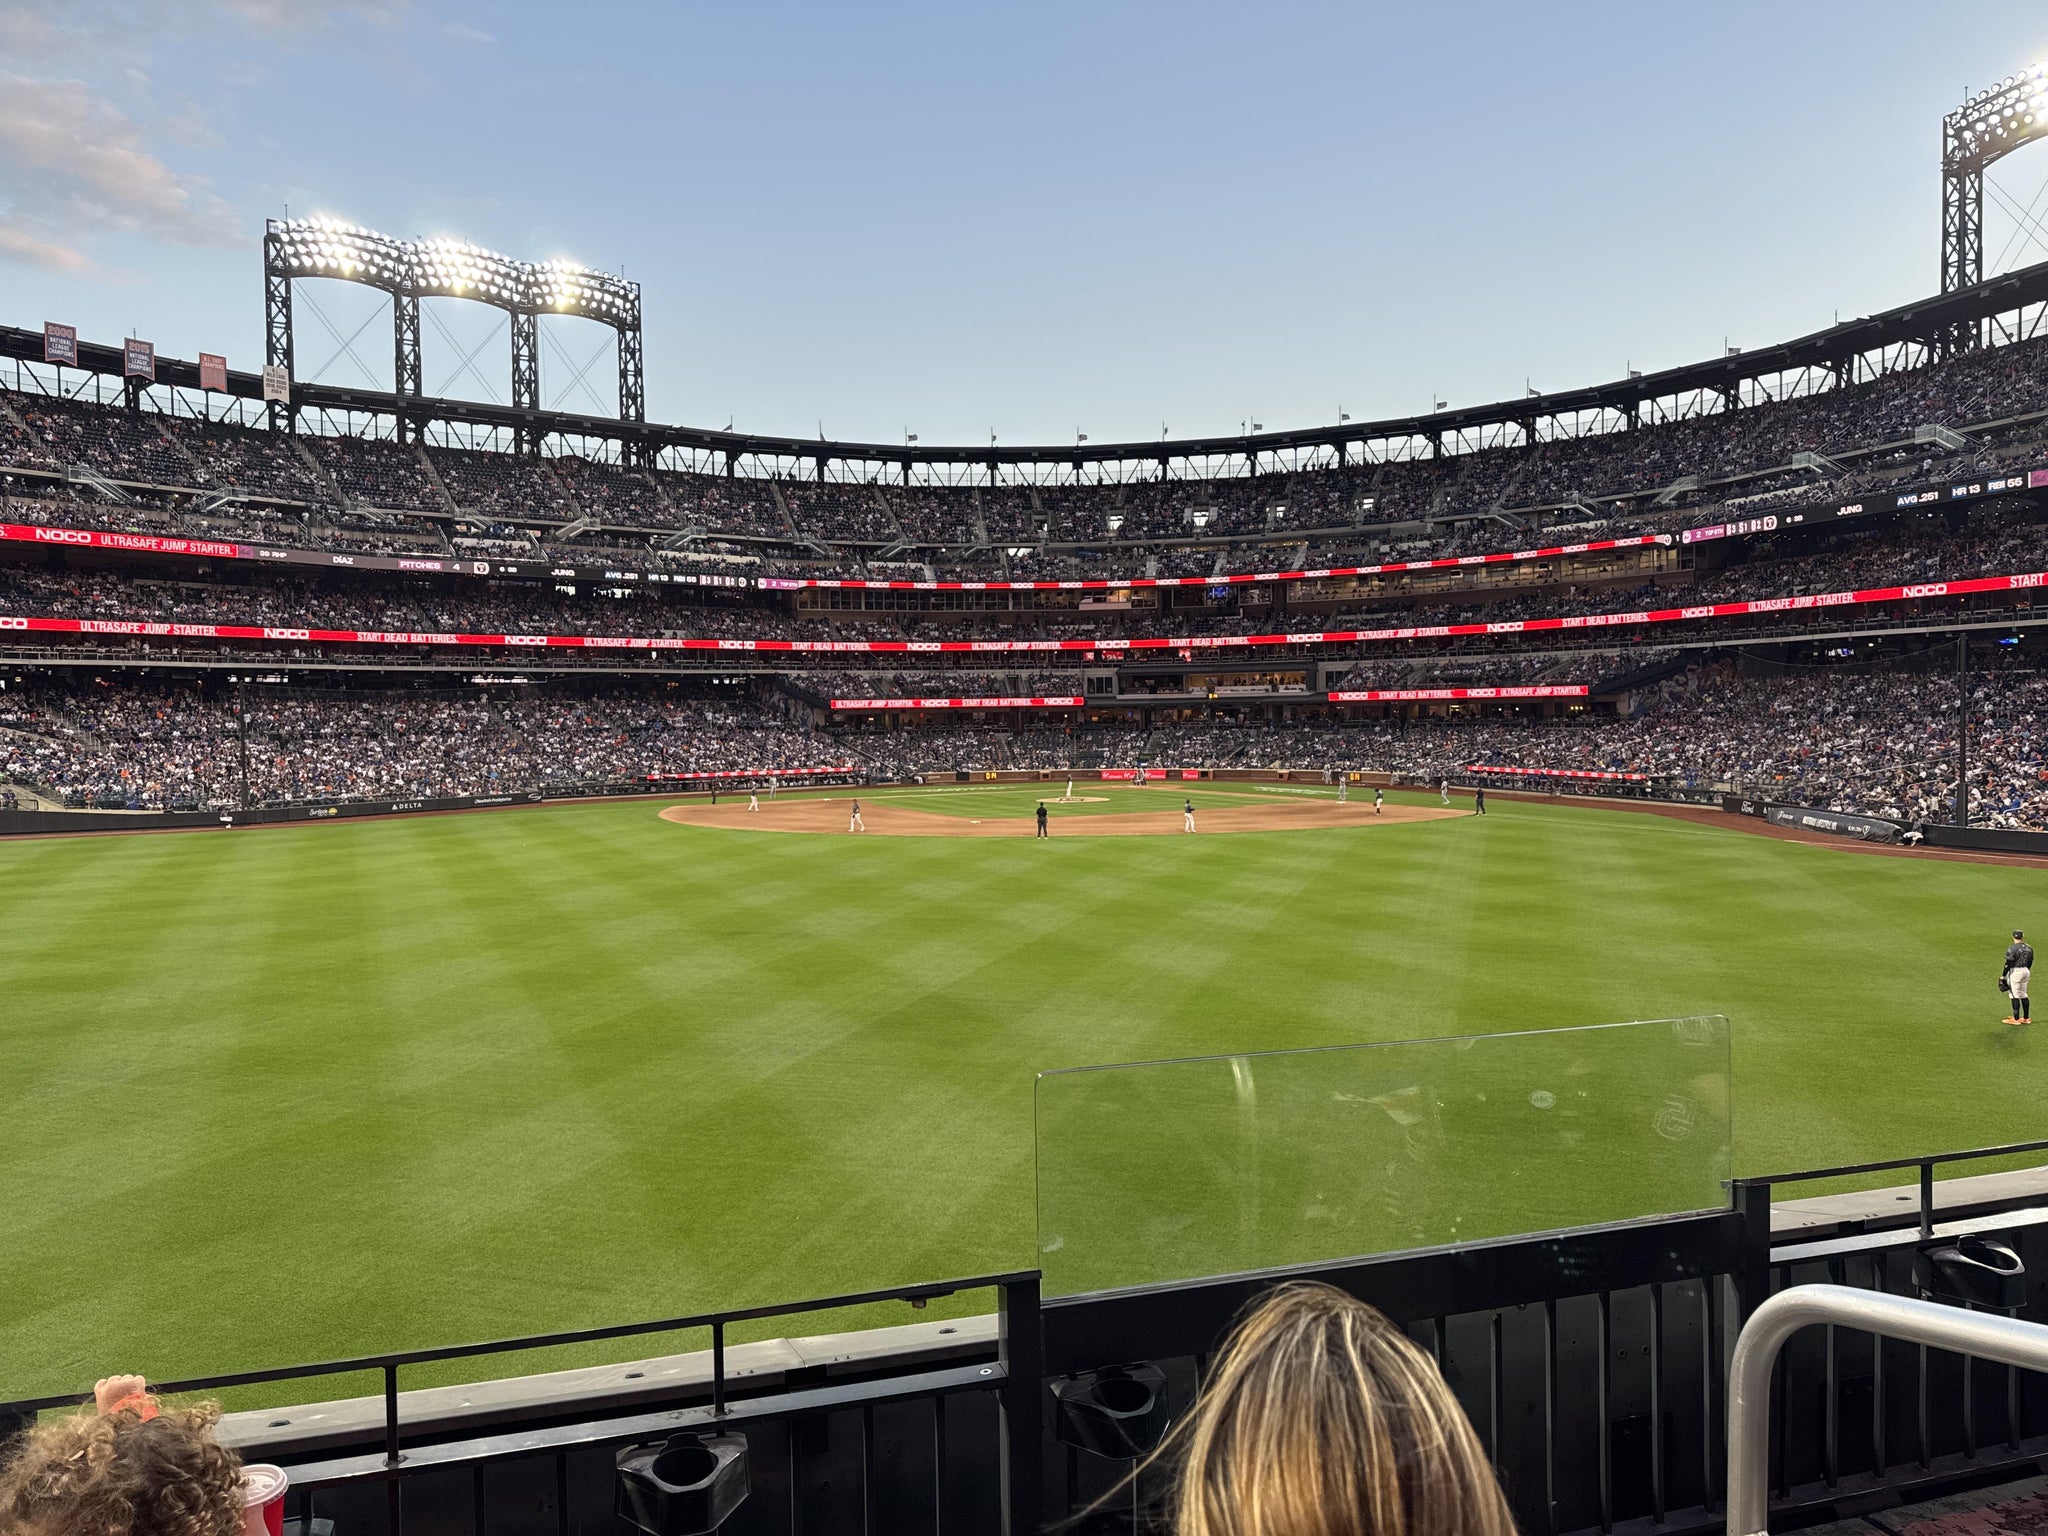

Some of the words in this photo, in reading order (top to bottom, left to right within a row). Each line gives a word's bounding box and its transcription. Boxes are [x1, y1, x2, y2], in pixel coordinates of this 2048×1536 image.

[48, 325, 73, 338] 2000
[50, 337, 72, 346] NATIONAL
[52, 343, 70, 351] LEAGUE
[128, 342, 150, 354] 2015
[48, 347, 74, 358] CHAMPIONS
[129, 352, 149, 361] NATIONAL
[132, 358, 148, 366] LEAGUE
[128, 362, 152, 373] CHAMPIONS
[1988, 481, 2005, 490] RBI
[2007, 478, 2023, 488] 55
[1952, 488, 1967, 496] HR
[1968, 485, 1980, 494] 13
[1897, 495, 1918, 506] AVG
[1919, 492, 1938, 502] .251
[1837, 504, 1862, 516] JUNG
[36, 529, 91, 543] NOCO
[101, 535, 157, 549] ULTRASAFE
[160, 538, 187, 551] JUMP
[190, 543, 234, 555] STARTER.
[1615, 537, 1642, 546] NOCO
[1562, 544, 1588, 553] NOCO
[1513, 550, 1537, 559] NOCO
[333, 555, 354, 565] DÍAZ
[1407, 561, 1432, 569] NOCO
[1458, 556, 1485, 565] NOCO
[400, 561, 440, 570] PITCHES
[1357, 566, 1381, 574] NOCO
[2010, 573, 2044, 588] START
[1903, 583, 1947, 598] NOCO
[1748, 600, 1791, 612] ULTRASAFE
[1792, 597, 1815, 608] JUMP
[1816, 592, 1855, 606] STARTER.
[0, 617, 28, 629] CO
[1562, 617, 1584, 626] START
[1586, 616, 1606, 625] DEAD
[81, 620, 139, 633] ULTRASAFE
[142, 623, 170, 634] JUMP
[173, 625, 218, 636] STARTER.
[1487, 622, 1524, 632] NOCO
[264, 628, 309, 639] NOCO
[357, 633, 382, 641] START
[384, 634, 407, 642] DEAD
[411, 634, 458, 643] BATTERIES.
[1286, 634, 1323, 642] NOCO
[1356, 629, 1395, 639] ULTRASAFE
[1396, 628, 1415, 637] JUMP
[505, 636, 547, 645] NOCO
[584, 638, 626, 647] ULTRASAFE
[629, 638, 650, 648] JUMP
[719, 641, 755, 649] NOCO
[1095, 640, 1130, 648] NOCO
[1378, 691, 1397, 699] START
[1501, 688, 1533, 696] ULTRASAFE
[1535, 687, 1552, 696] JUMP
[836, 700, 868, 708] ULTRASAFE
[869, 700, 887, 708] JUMP
[1741, 801, 1754, 814] Ford
